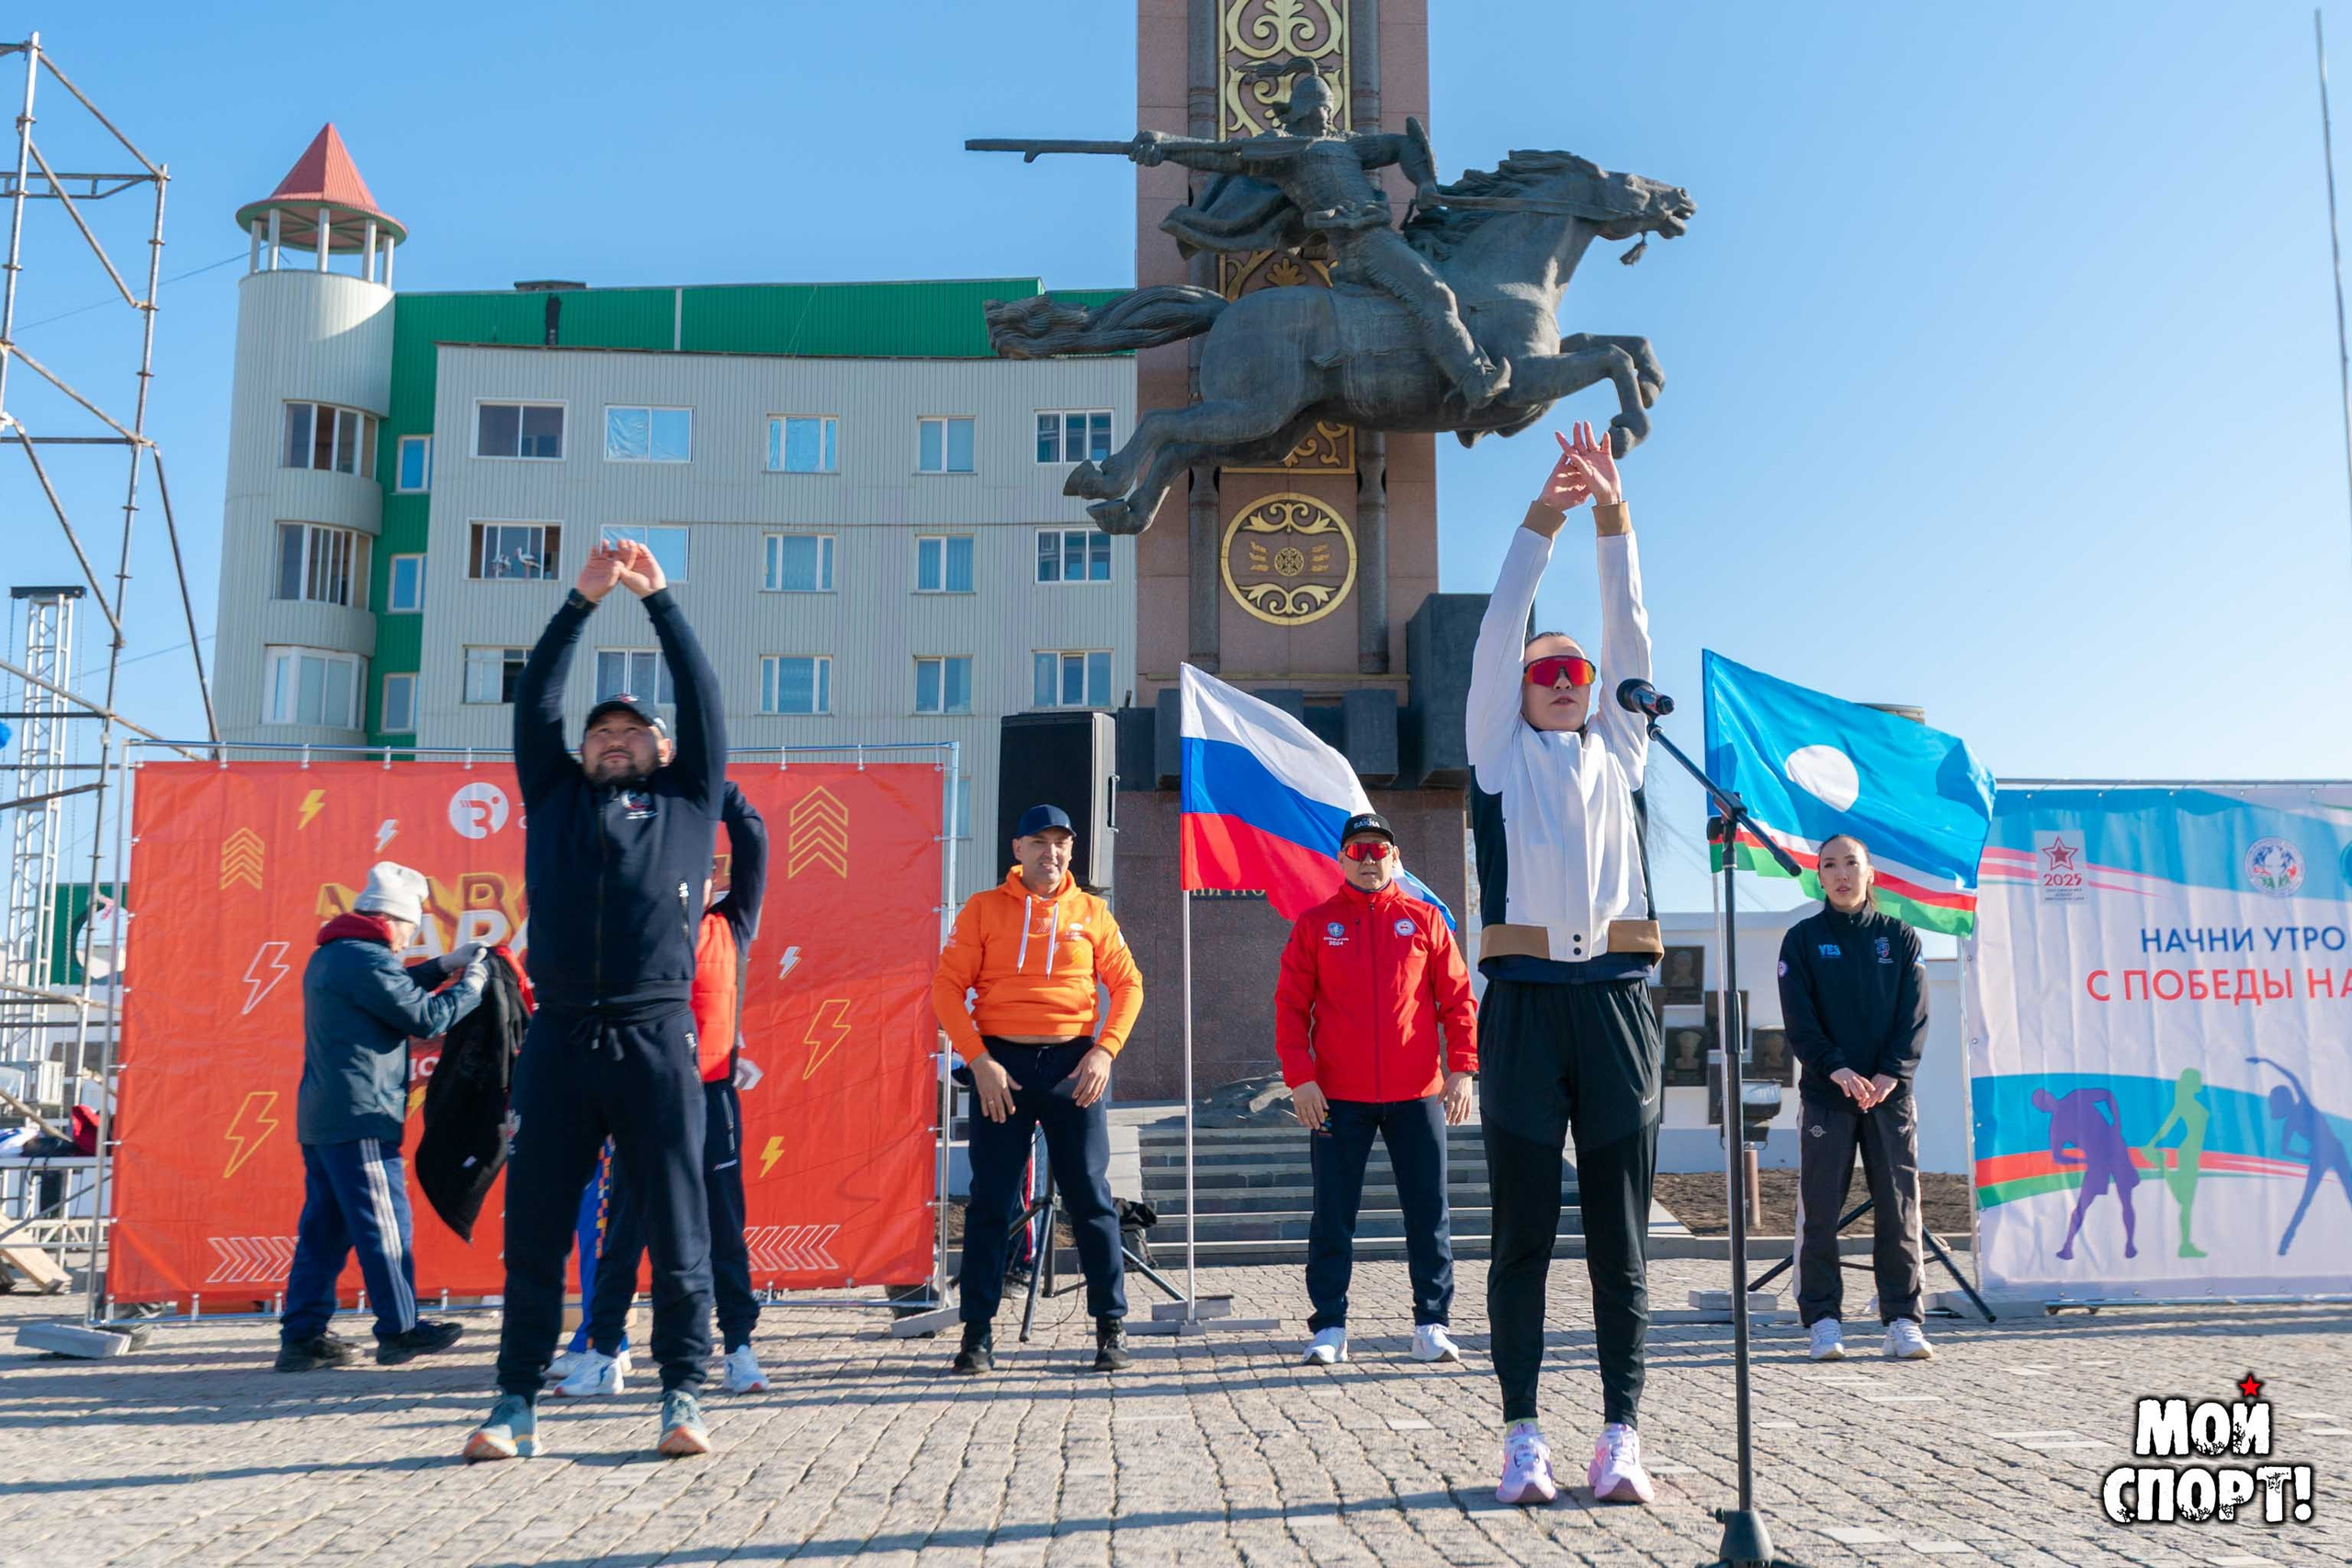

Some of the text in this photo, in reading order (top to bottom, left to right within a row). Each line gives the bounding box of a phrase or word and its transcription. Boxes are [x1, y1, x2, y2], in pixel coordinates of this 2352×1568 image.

[2043, 874, 2082, 886] 2025
[2141, 926, 2346, 953] НАЧНИ УТРО
[1818, 944, 1841, 955] YES
[2086, 970, 2110, 1001] С
[2123, 968, 2293, 1006] ПОБЕДЫ
